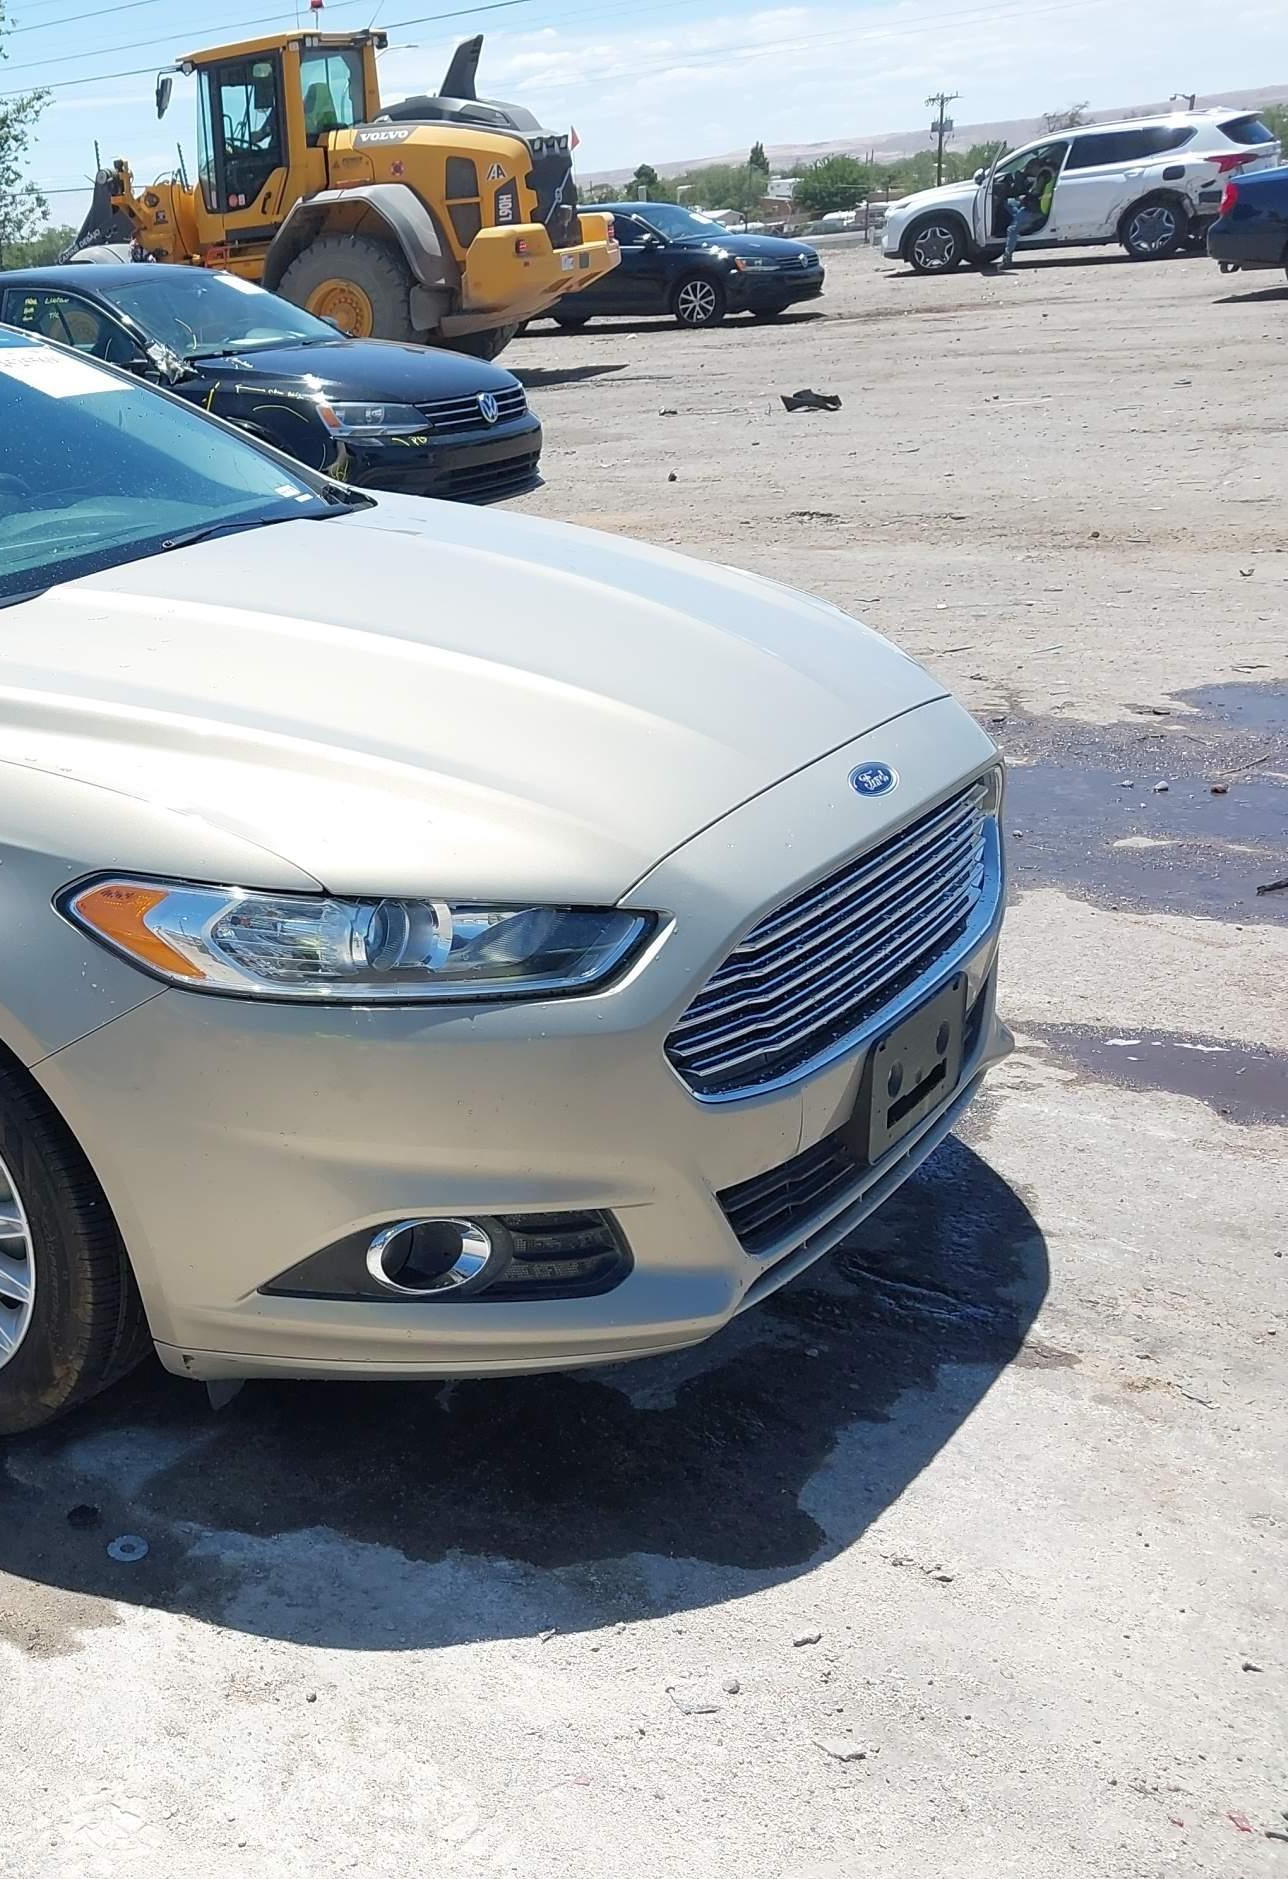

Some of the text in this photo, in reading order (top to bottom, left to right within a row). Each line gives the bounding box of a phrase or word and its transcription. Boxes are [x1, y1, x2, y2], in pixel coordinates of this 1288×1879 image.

[360, 130, 409, 142] VOLVO
[498, 193, 513, 222] L90H
[858, 769, 889, 791] Ford
